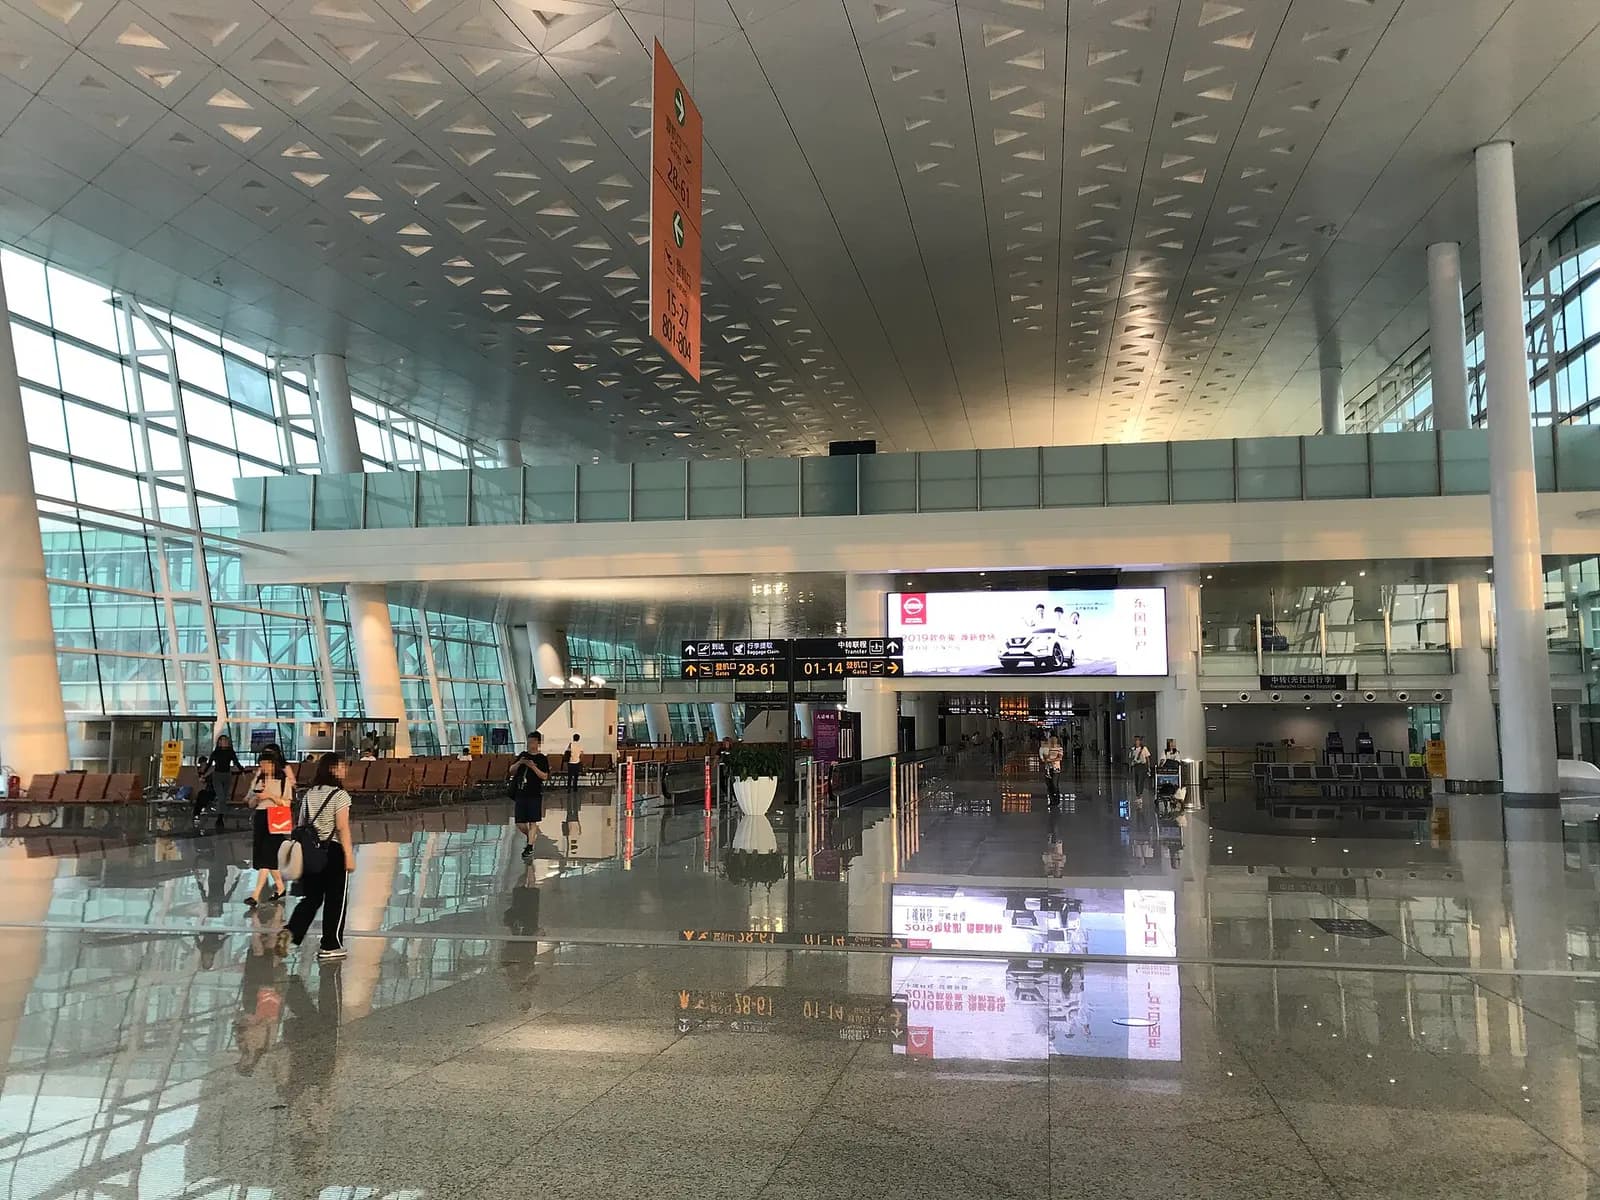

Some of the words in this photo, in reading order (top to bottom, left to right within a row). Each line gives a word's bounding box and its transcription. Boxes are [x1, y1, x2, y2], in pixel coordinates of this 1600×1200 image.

[667, 158, 689, 208] 28-61
[666, 288, 689, 330] 15-27
[662, 314, 692, 363] 801-804
[715, 663, 737, 671] 登机口
[738, 663, 775, 675] 28-61
[804, 662, 843, 675] 01-14
[846, 661, 868, 669] 登机口
